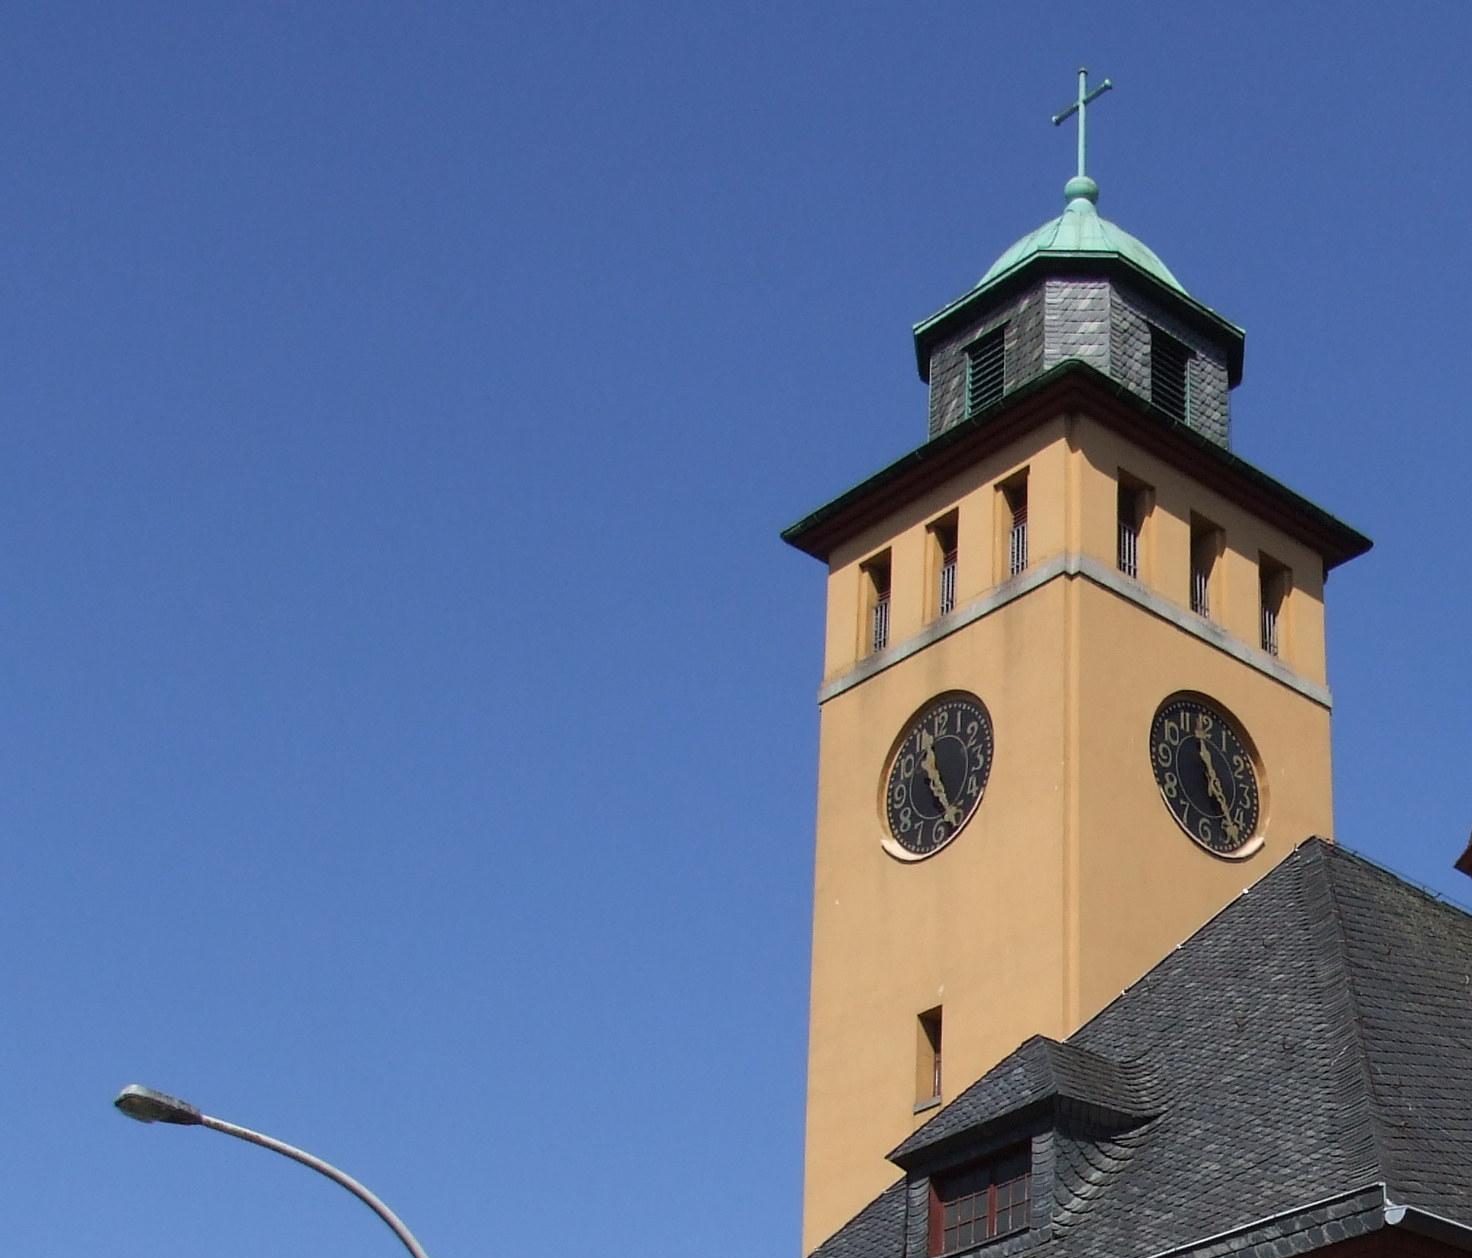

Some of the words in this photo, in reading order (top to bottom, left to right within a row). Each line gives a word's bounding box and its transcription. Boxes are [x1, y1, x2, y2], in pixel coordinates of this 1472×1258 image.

[934, 711, 948, 737] 12
[955, 711, 962, 733] 1
[1164, 719, 1179, 746] 10
[1180, 709, 1190, 732] 11
[966, 721, 979, 748] 2
[1221, 730, 1227, 752] 1
[900, 753, 915, 780] 10
[972, 744, 984, 772] 3
[1158, 743, 1172, 768] 9
[1233, 755, 1244, 779] 2
[893, 784, 906, 809] 9
[967, 774, 978, 797] 4
[1164, 772, 1177, 798] 8
[1239, 784, 1250, 809] 3
[900, 807, 911, 832] 8
[1180, 799, 1190, 824] 7
[1234, 808, 1246, 831] 4
[914, 820, 924, 846] 7
[932, 818, 944, 843] 6
[1199, 818, 1211, 842] 6
